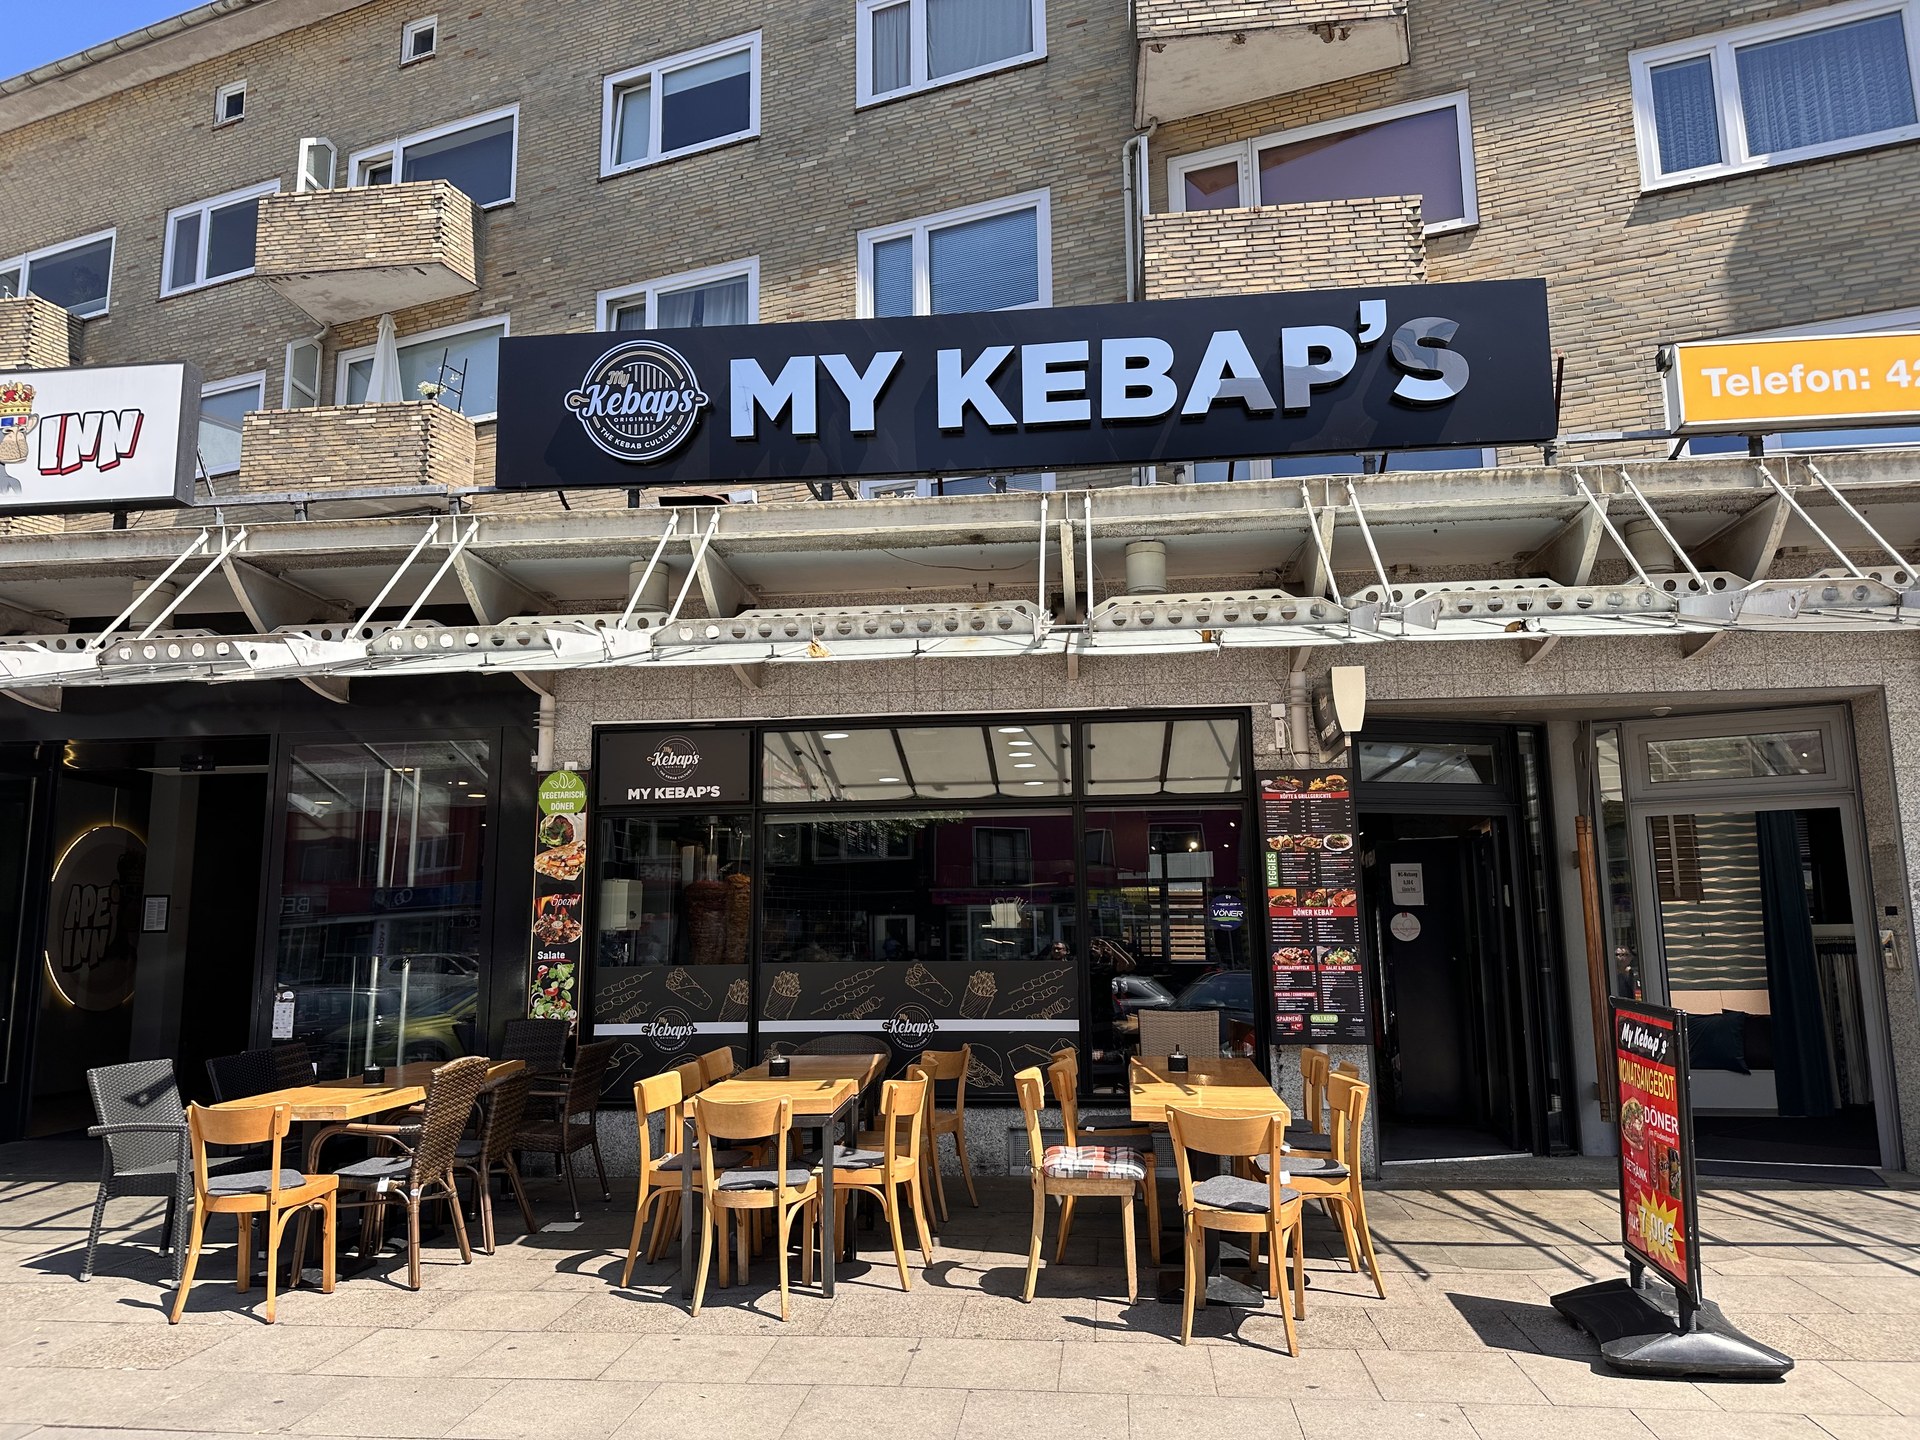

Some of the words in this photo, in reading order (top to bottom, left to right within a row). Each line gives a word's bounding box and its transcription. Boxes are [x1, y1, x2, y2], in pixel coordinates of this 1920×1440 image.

[606, 370, 630, 387] My
[729, 350, 903, 439] MY
[936, 299, 1471, 430] KEBAP'S
[1701, 363, 1871, 397] Telefon:
[582, 381, 695, 422] Kebap's
[38, 408, 144, 476] INN
[600, 427, 613, 442] THE
[614, 438, 642, 449] KEBAB
[645, 425, 678, 448] CULTURE
[652, 751, 700, 769] Kebap's
[541, 791, 584, 800] VEGETARISCH
[627, 788, 652, 800] MY
[654, 785, 721, 800] KEBAP'S
[550, 801, 575, 811] DÖNER
[1267, 853, 1277, 886] VEGGIES
[63, 884, 112, 929] APE
[1212, 908, 1244, 917] VÖNER
[1292, 907, 1313, 916] DÖNER
[1313, 907, 1334, 916] KEBAP
[62, 928, 110, 972] INN
[537, 951, 566, 960] Salate
[647, 1022, 693, 1040] Kebap's
[888, 1019, 935, 1037] Kebap's
[1621, 1022, 1634, 1048] My
[1644, 1105, 1679, 1136] DÖNER
